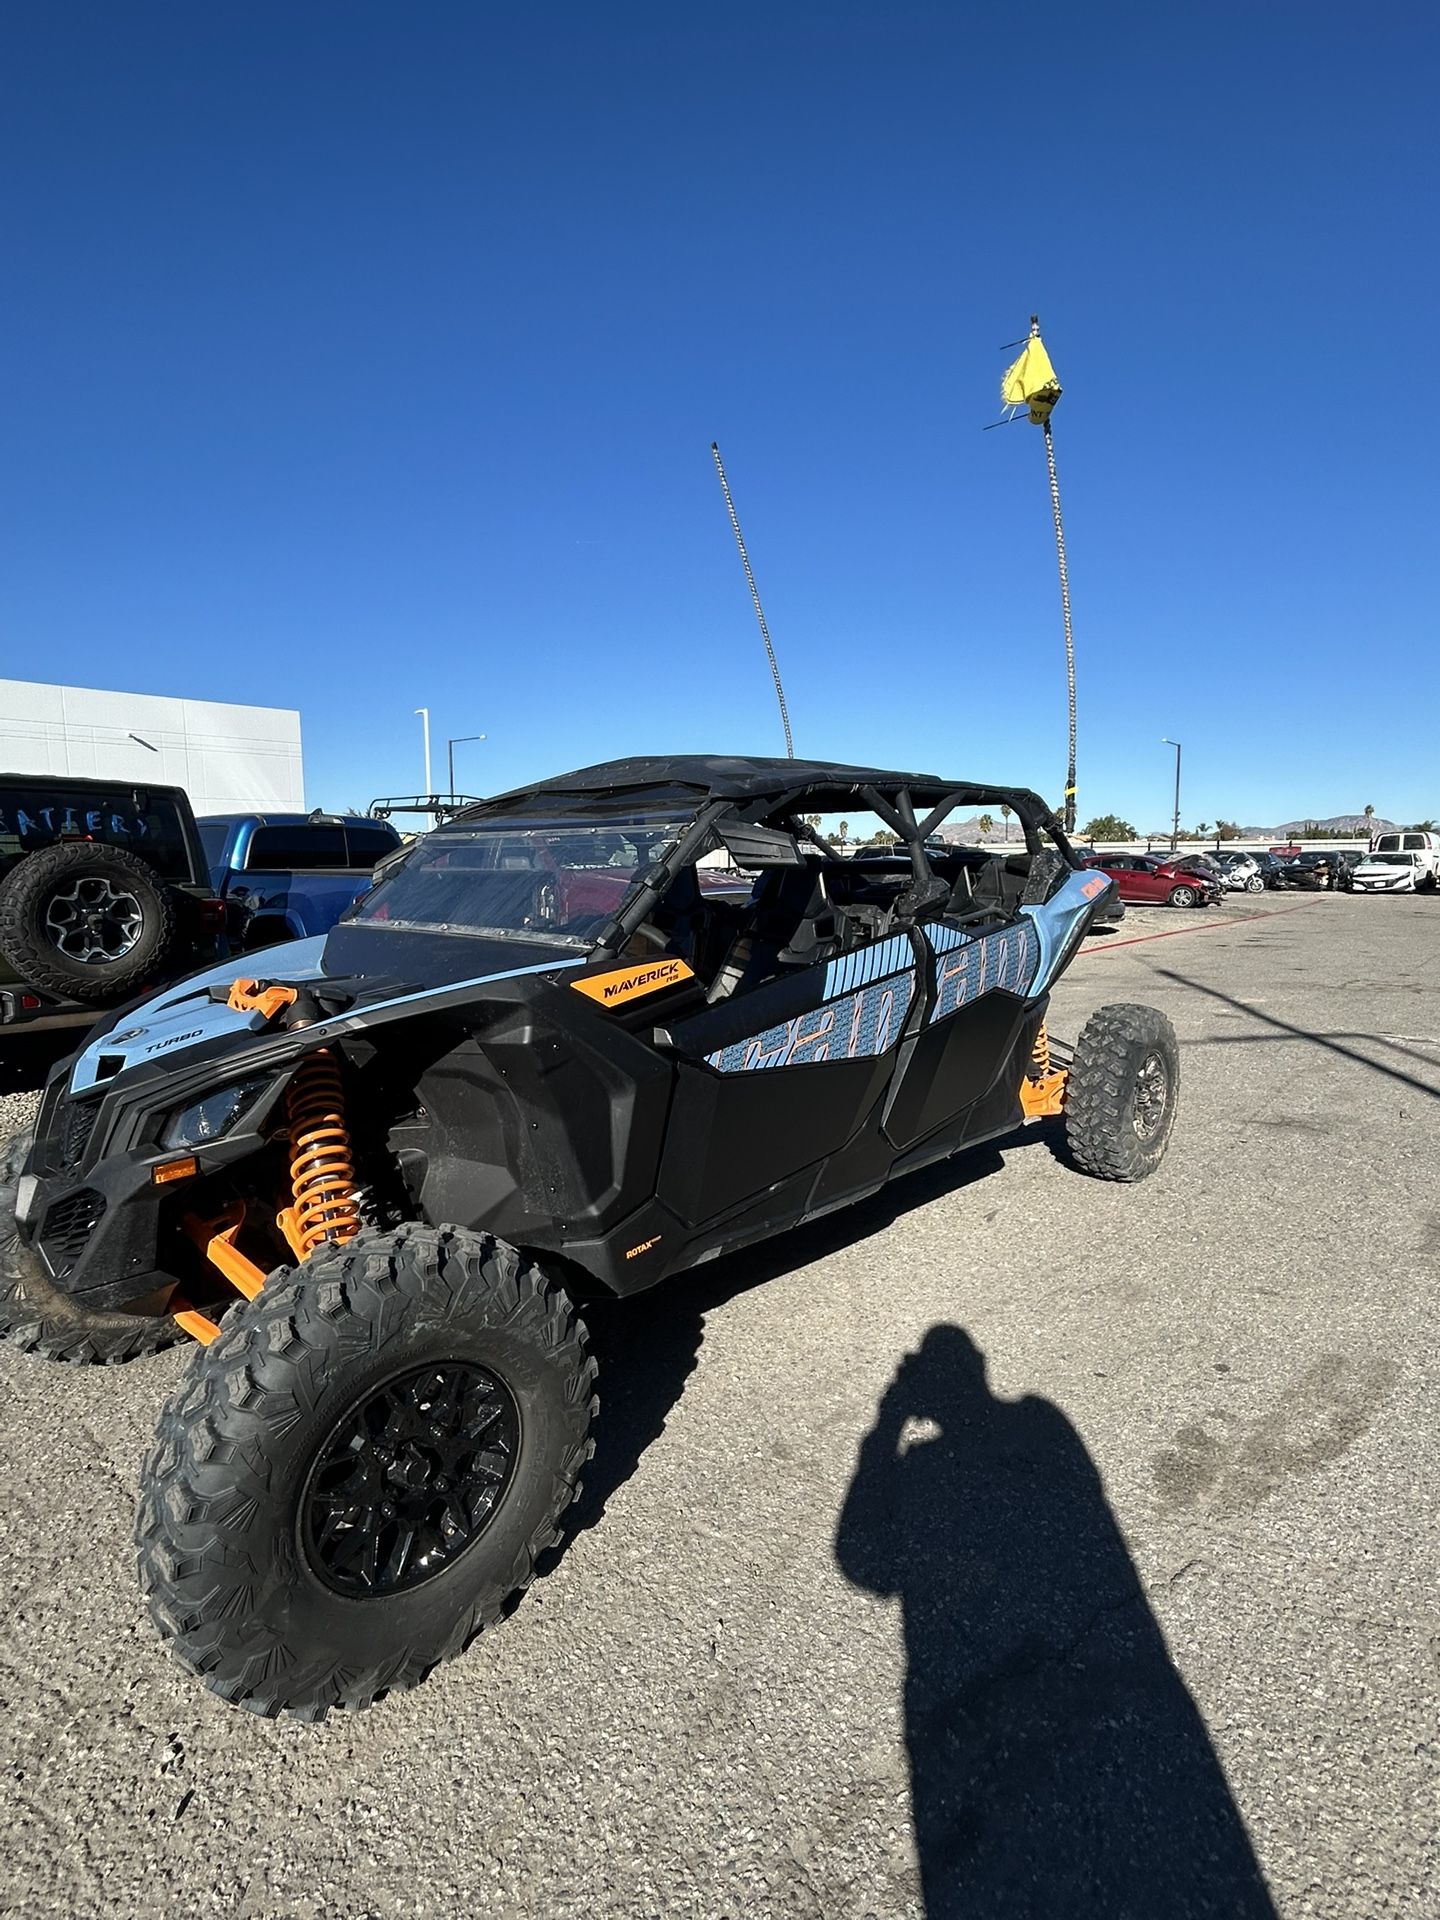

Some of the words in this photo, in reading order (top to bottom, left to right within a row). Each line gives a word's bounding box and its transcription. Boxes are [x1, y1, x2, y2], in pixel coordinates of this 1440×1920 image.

[604, 962, 679, 998] MAVERICK
[146, 1029, 203, 1053] TURBO
[626, 1240, 652, 1259] ROTAX
